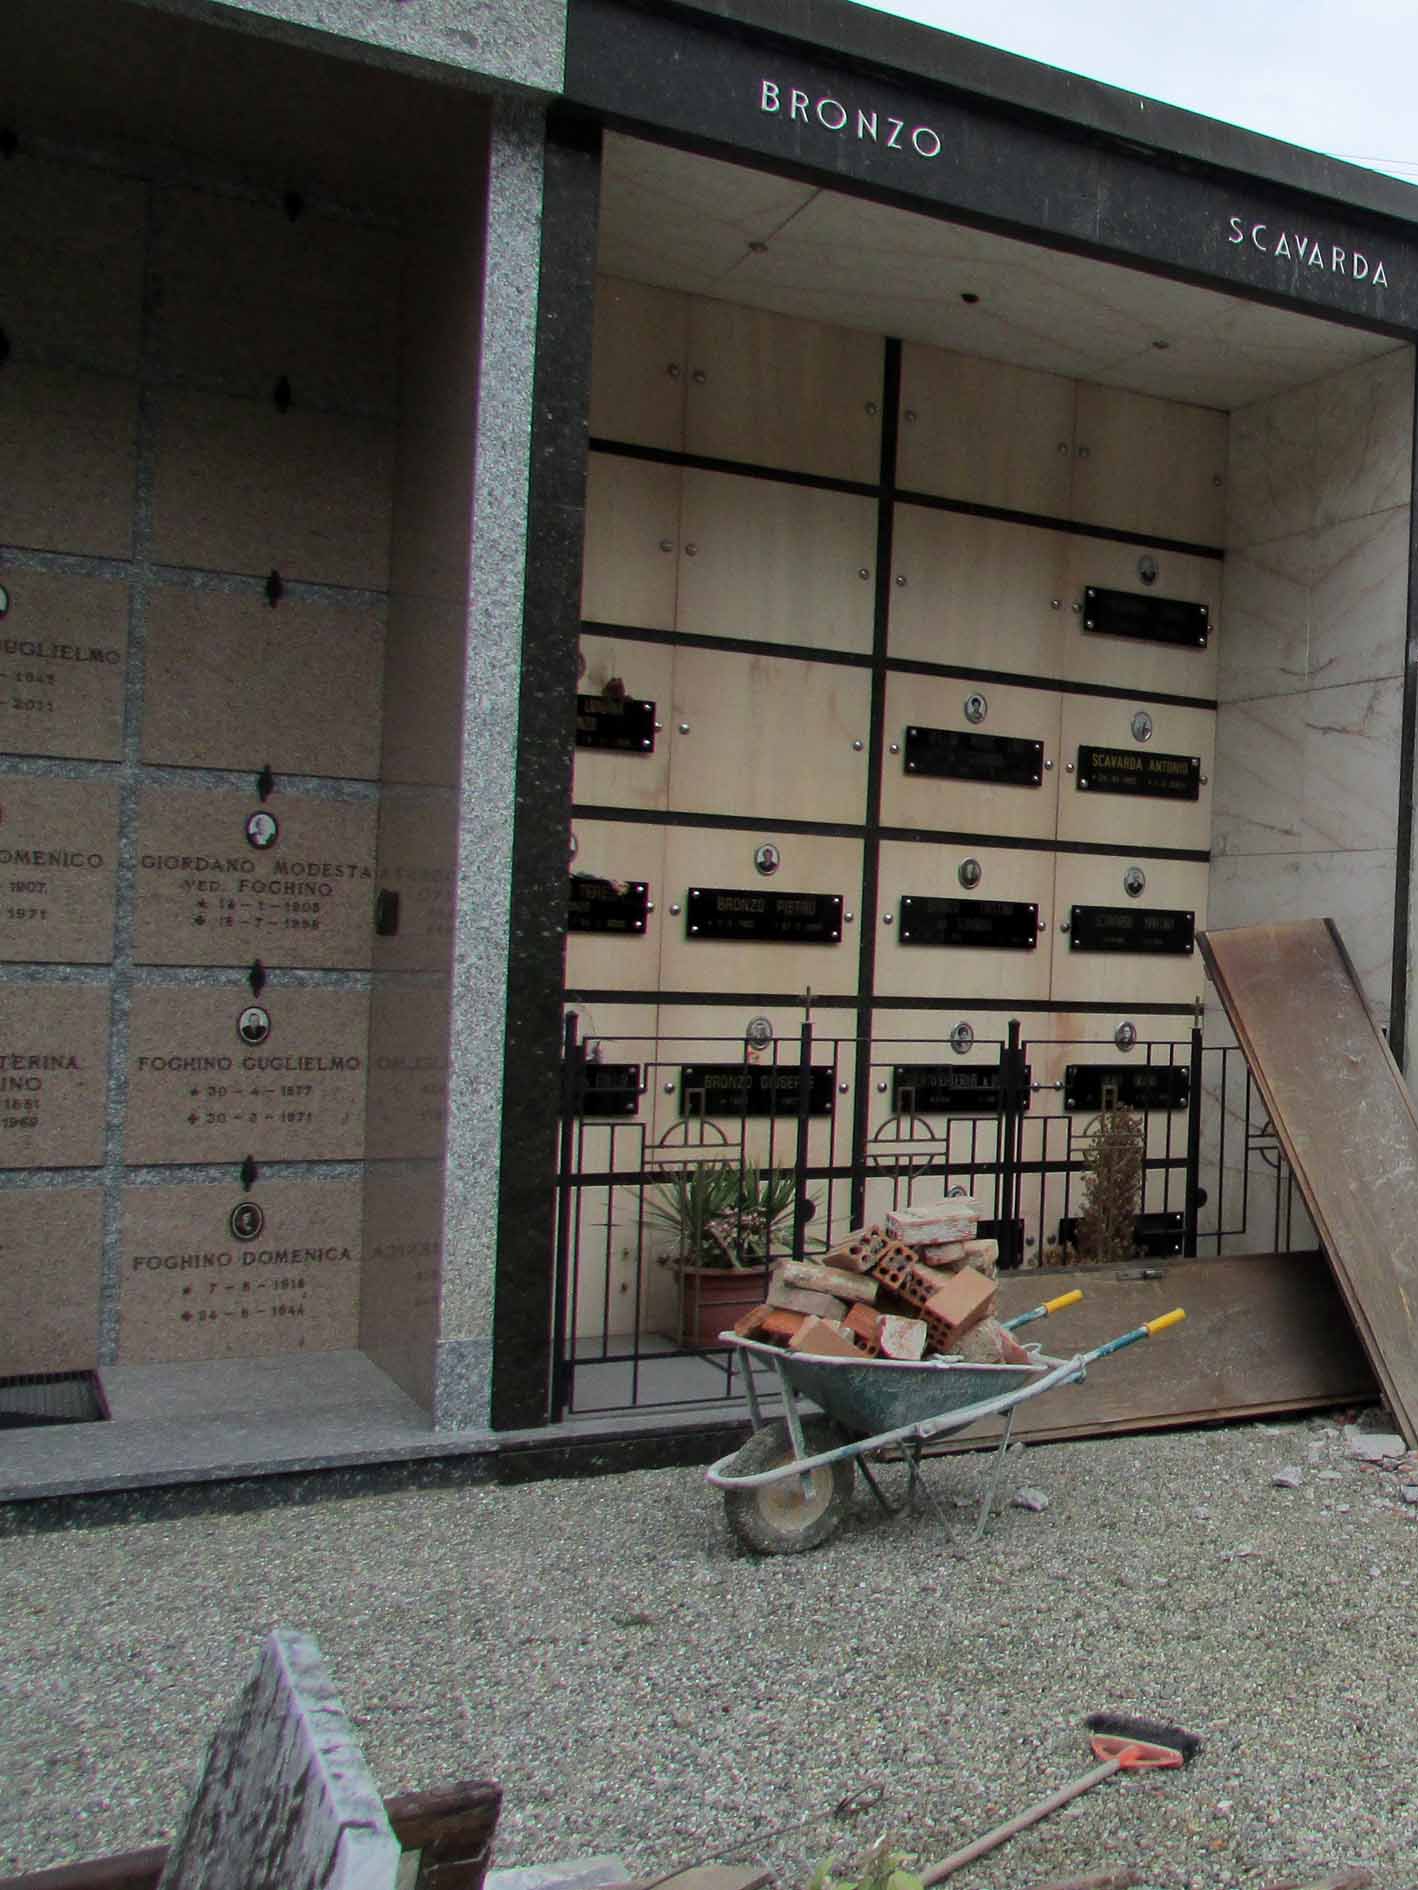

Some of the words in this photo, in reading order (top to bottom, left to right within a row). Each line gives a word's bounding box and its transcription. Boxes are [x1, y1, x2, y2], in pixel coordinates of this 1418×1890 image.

[760, 79, 942, 158] BRONZO
[1227, 216, 1390, 288] SCAVARDA
[1091, 753, 1143, 771] SCAVARDA
[141, 855, 255, 874] GIORDANO
[273, 861, 371, 880] MODESTA
[237, 878, 333, 897] FOGHINO
[137, 1055, 233, 1072] FOGHINO
[241, 1055, 362, 1072] GUGLIELMO
[131, 1251, 233, 1272] FOGHINO
[242, 1246, 352, 1268] DOMENICA
